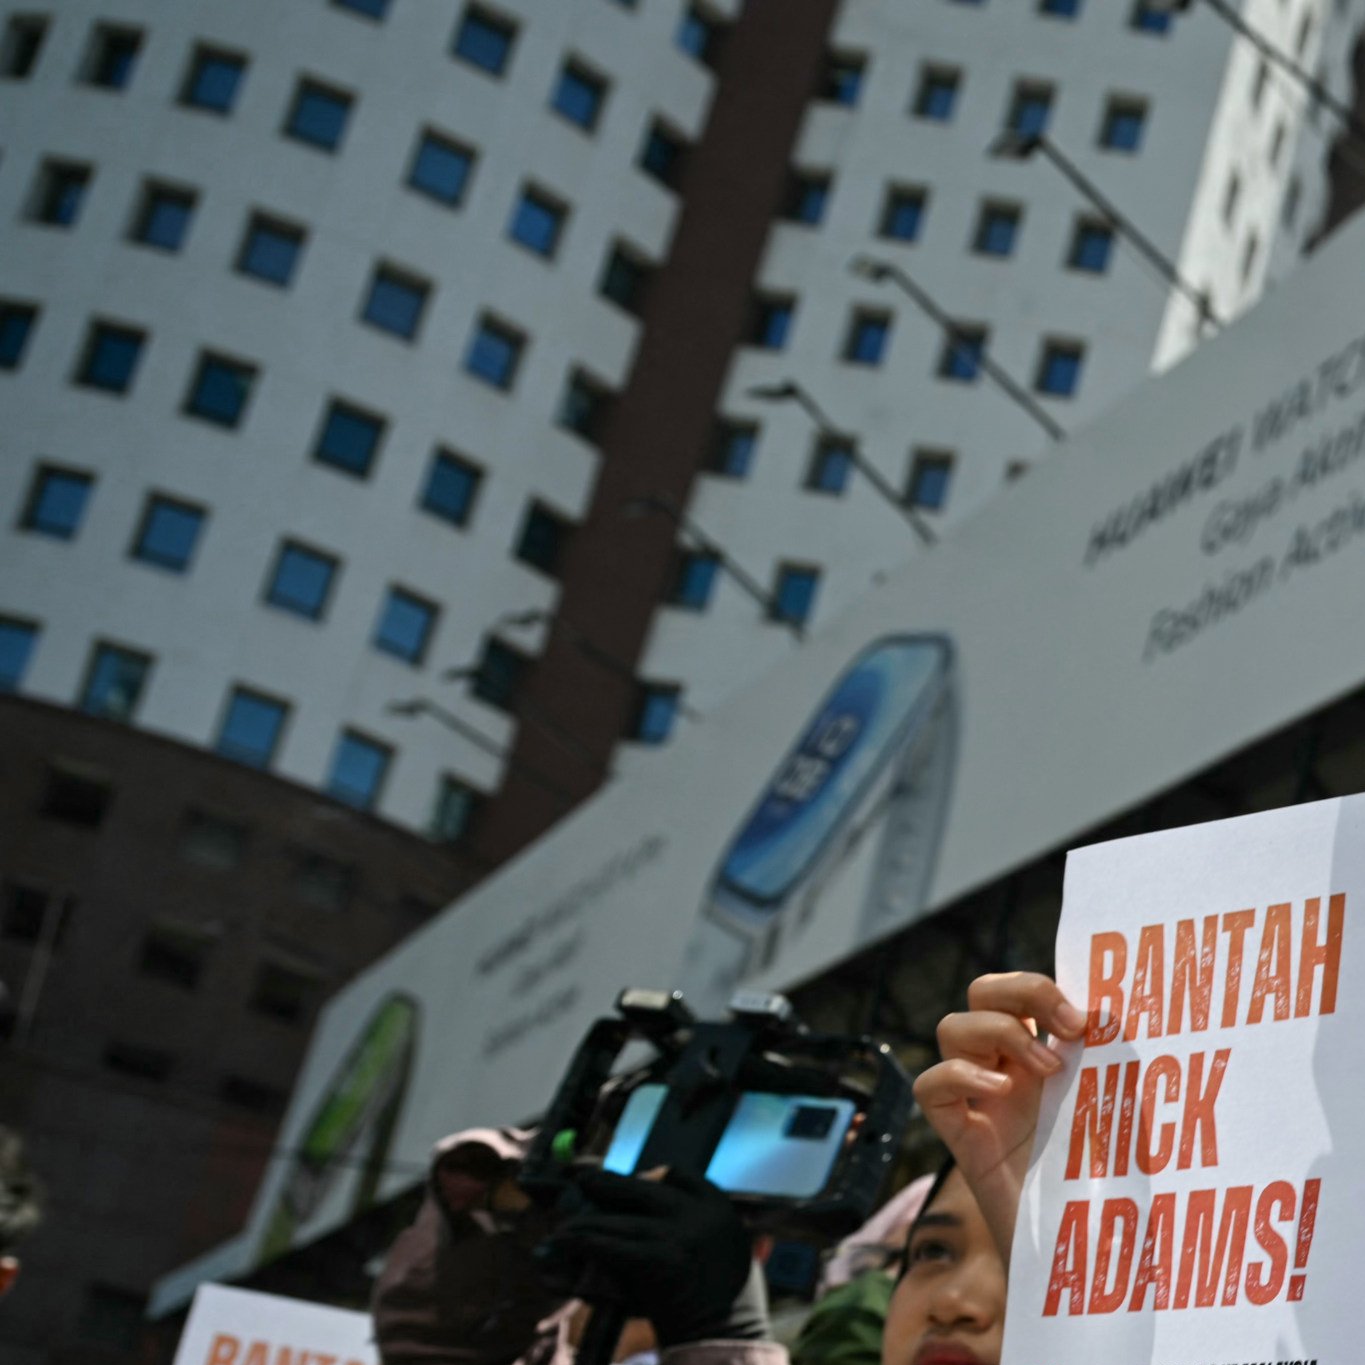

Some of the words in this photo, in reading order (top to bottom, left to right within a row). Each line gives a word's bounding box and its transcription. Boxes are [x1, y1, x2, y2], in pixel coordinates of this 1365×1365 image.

[1081, 423, 1245, 567] HUAWEI
[1202, 475, 1285, 557] Gaya
[1142, 554, 1276, 665] Fashion
[1083, 892, 1346, 1048] BANTAH
[1063, 1047, 1232, 1181] NICK
[1041, 1177, 1322, 1317] ADAMS!
